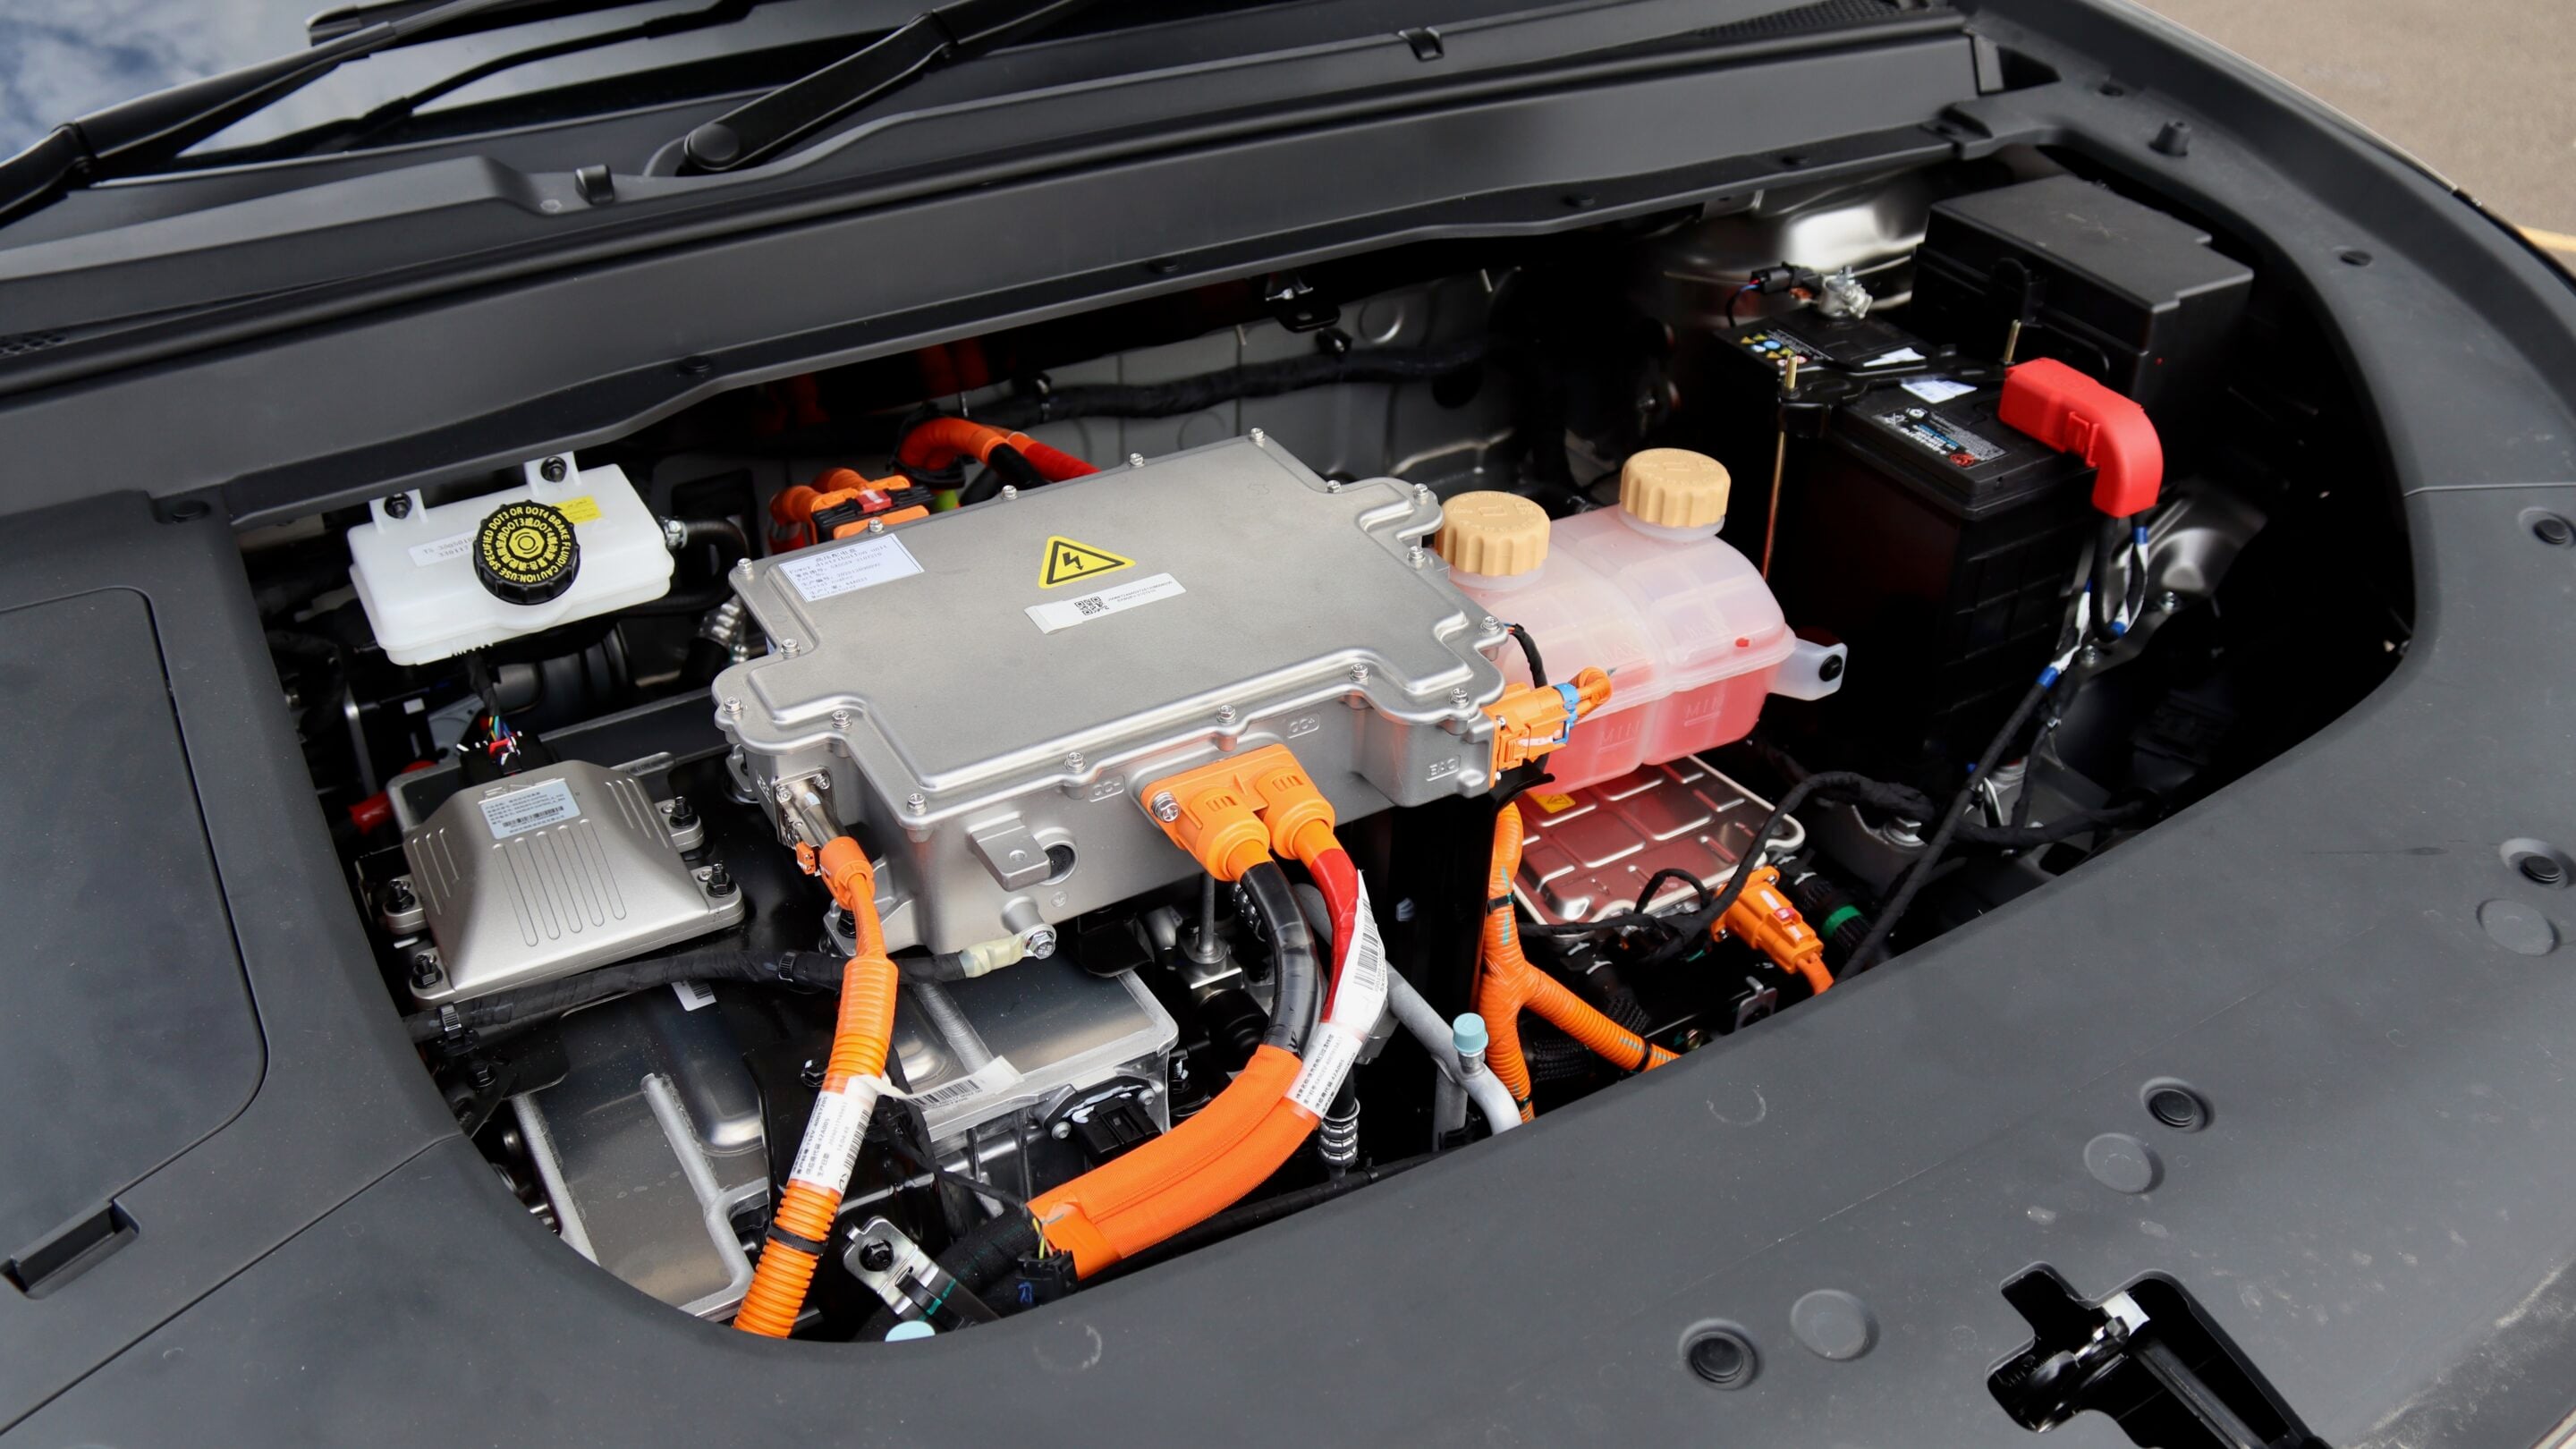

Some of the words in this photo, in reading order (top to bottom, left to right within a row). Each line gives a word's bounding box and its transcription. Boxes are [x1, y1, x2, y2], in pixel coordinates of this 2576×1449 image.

[488, 511, 509, 530] DOT3
[510, 506, 523, 516] OR
[525, 506, 549, 519] DOT4
[548, 514, 571, 540] BRAKE
[483, 530, 501, 571] SPECIFIED
[1684, 695, 1724, 719] MIN
[1599, 720, 1640, 746] MIN
